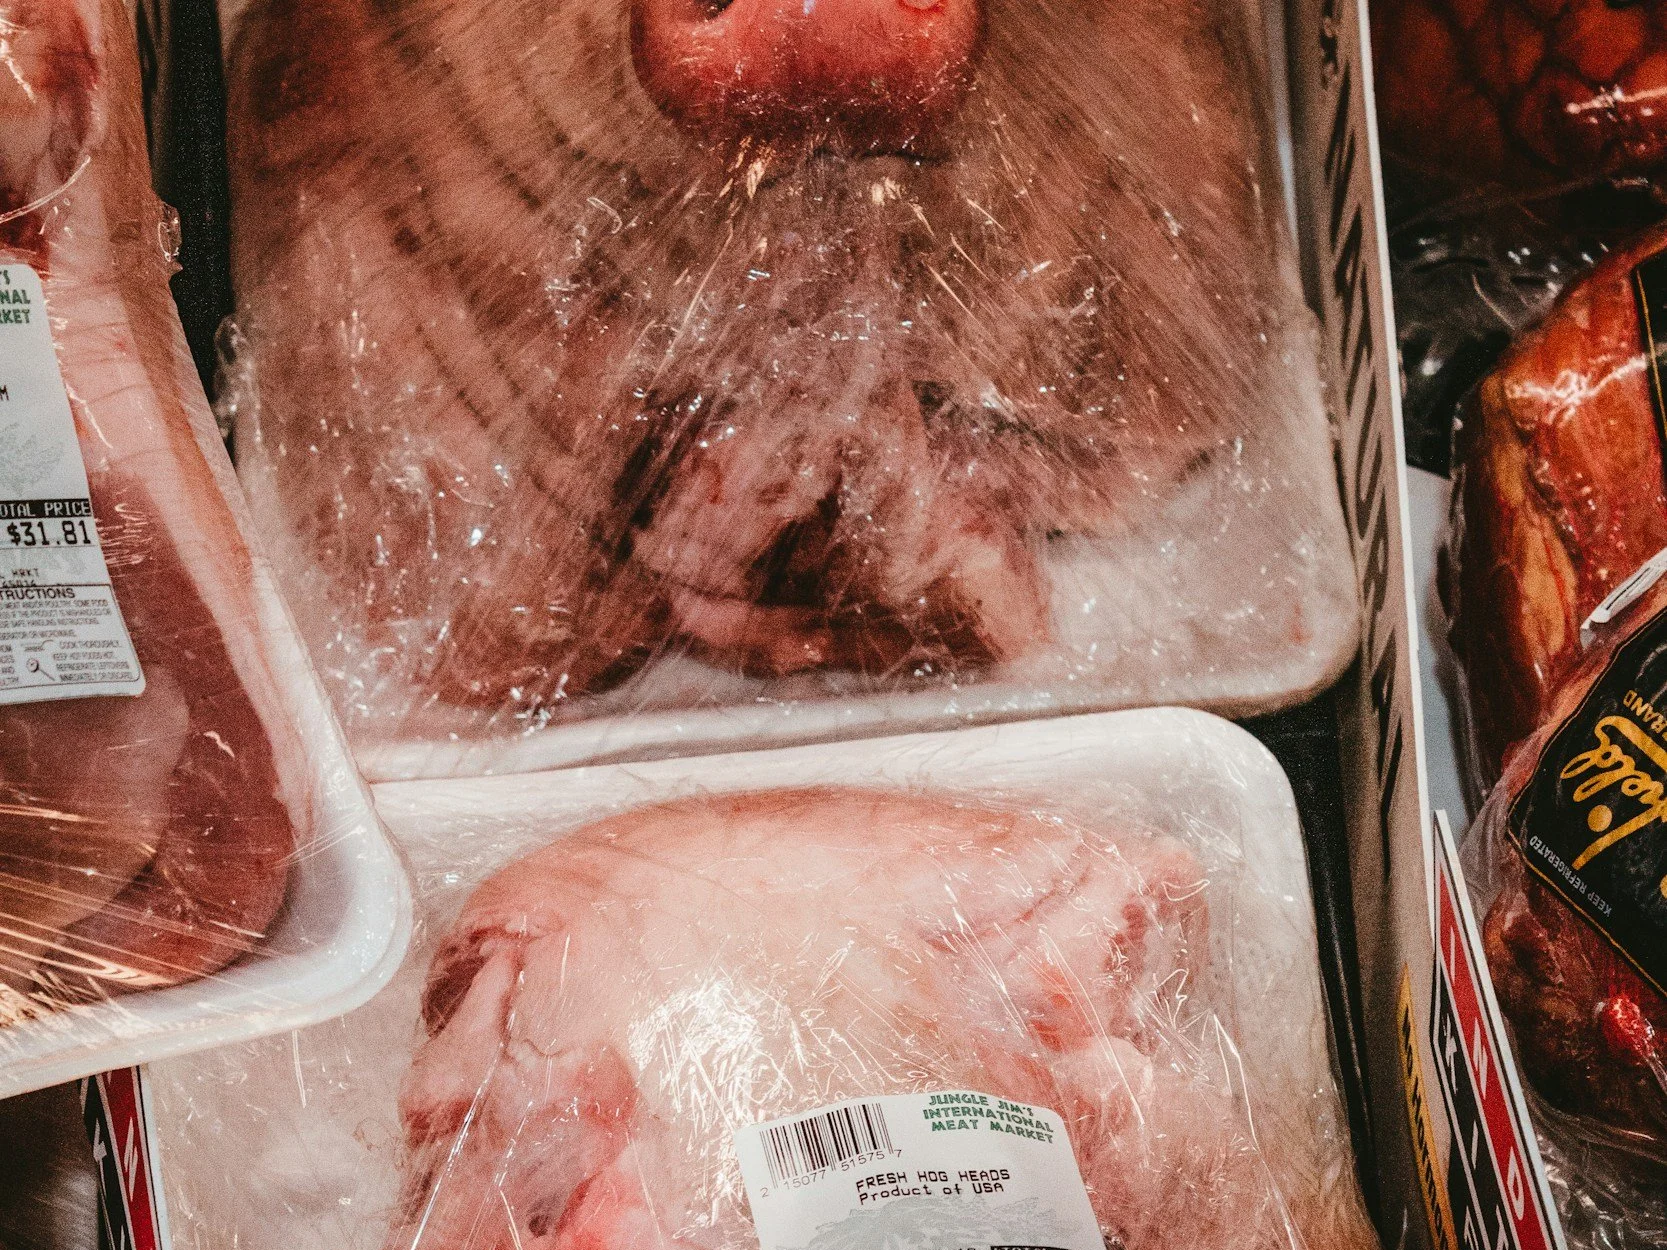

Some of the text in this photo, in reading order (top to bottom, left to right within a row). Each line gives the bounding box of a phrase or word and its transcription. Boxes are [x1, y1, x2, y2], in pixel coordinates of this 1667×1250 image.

[44, 501, 92, 516] PRICE
[6, 520, 92, 546] $31.81
[1528, 834, 1612, 918] KEEP REFRIGERATED
[928, 1093, 1034, 1118] JUNGLE JIM'S
[922, 1106, 1054, 1133] INTERNATIONAL
[931, 1119, 1053, 1144] MEAT MARKET
[760, 1149, 902, 1199] 2 15077 51575 7
[856, 1169, 1011, 1194] FRESH HOG HEADS
[858, 1182, 1005, 1206] Product of USA
